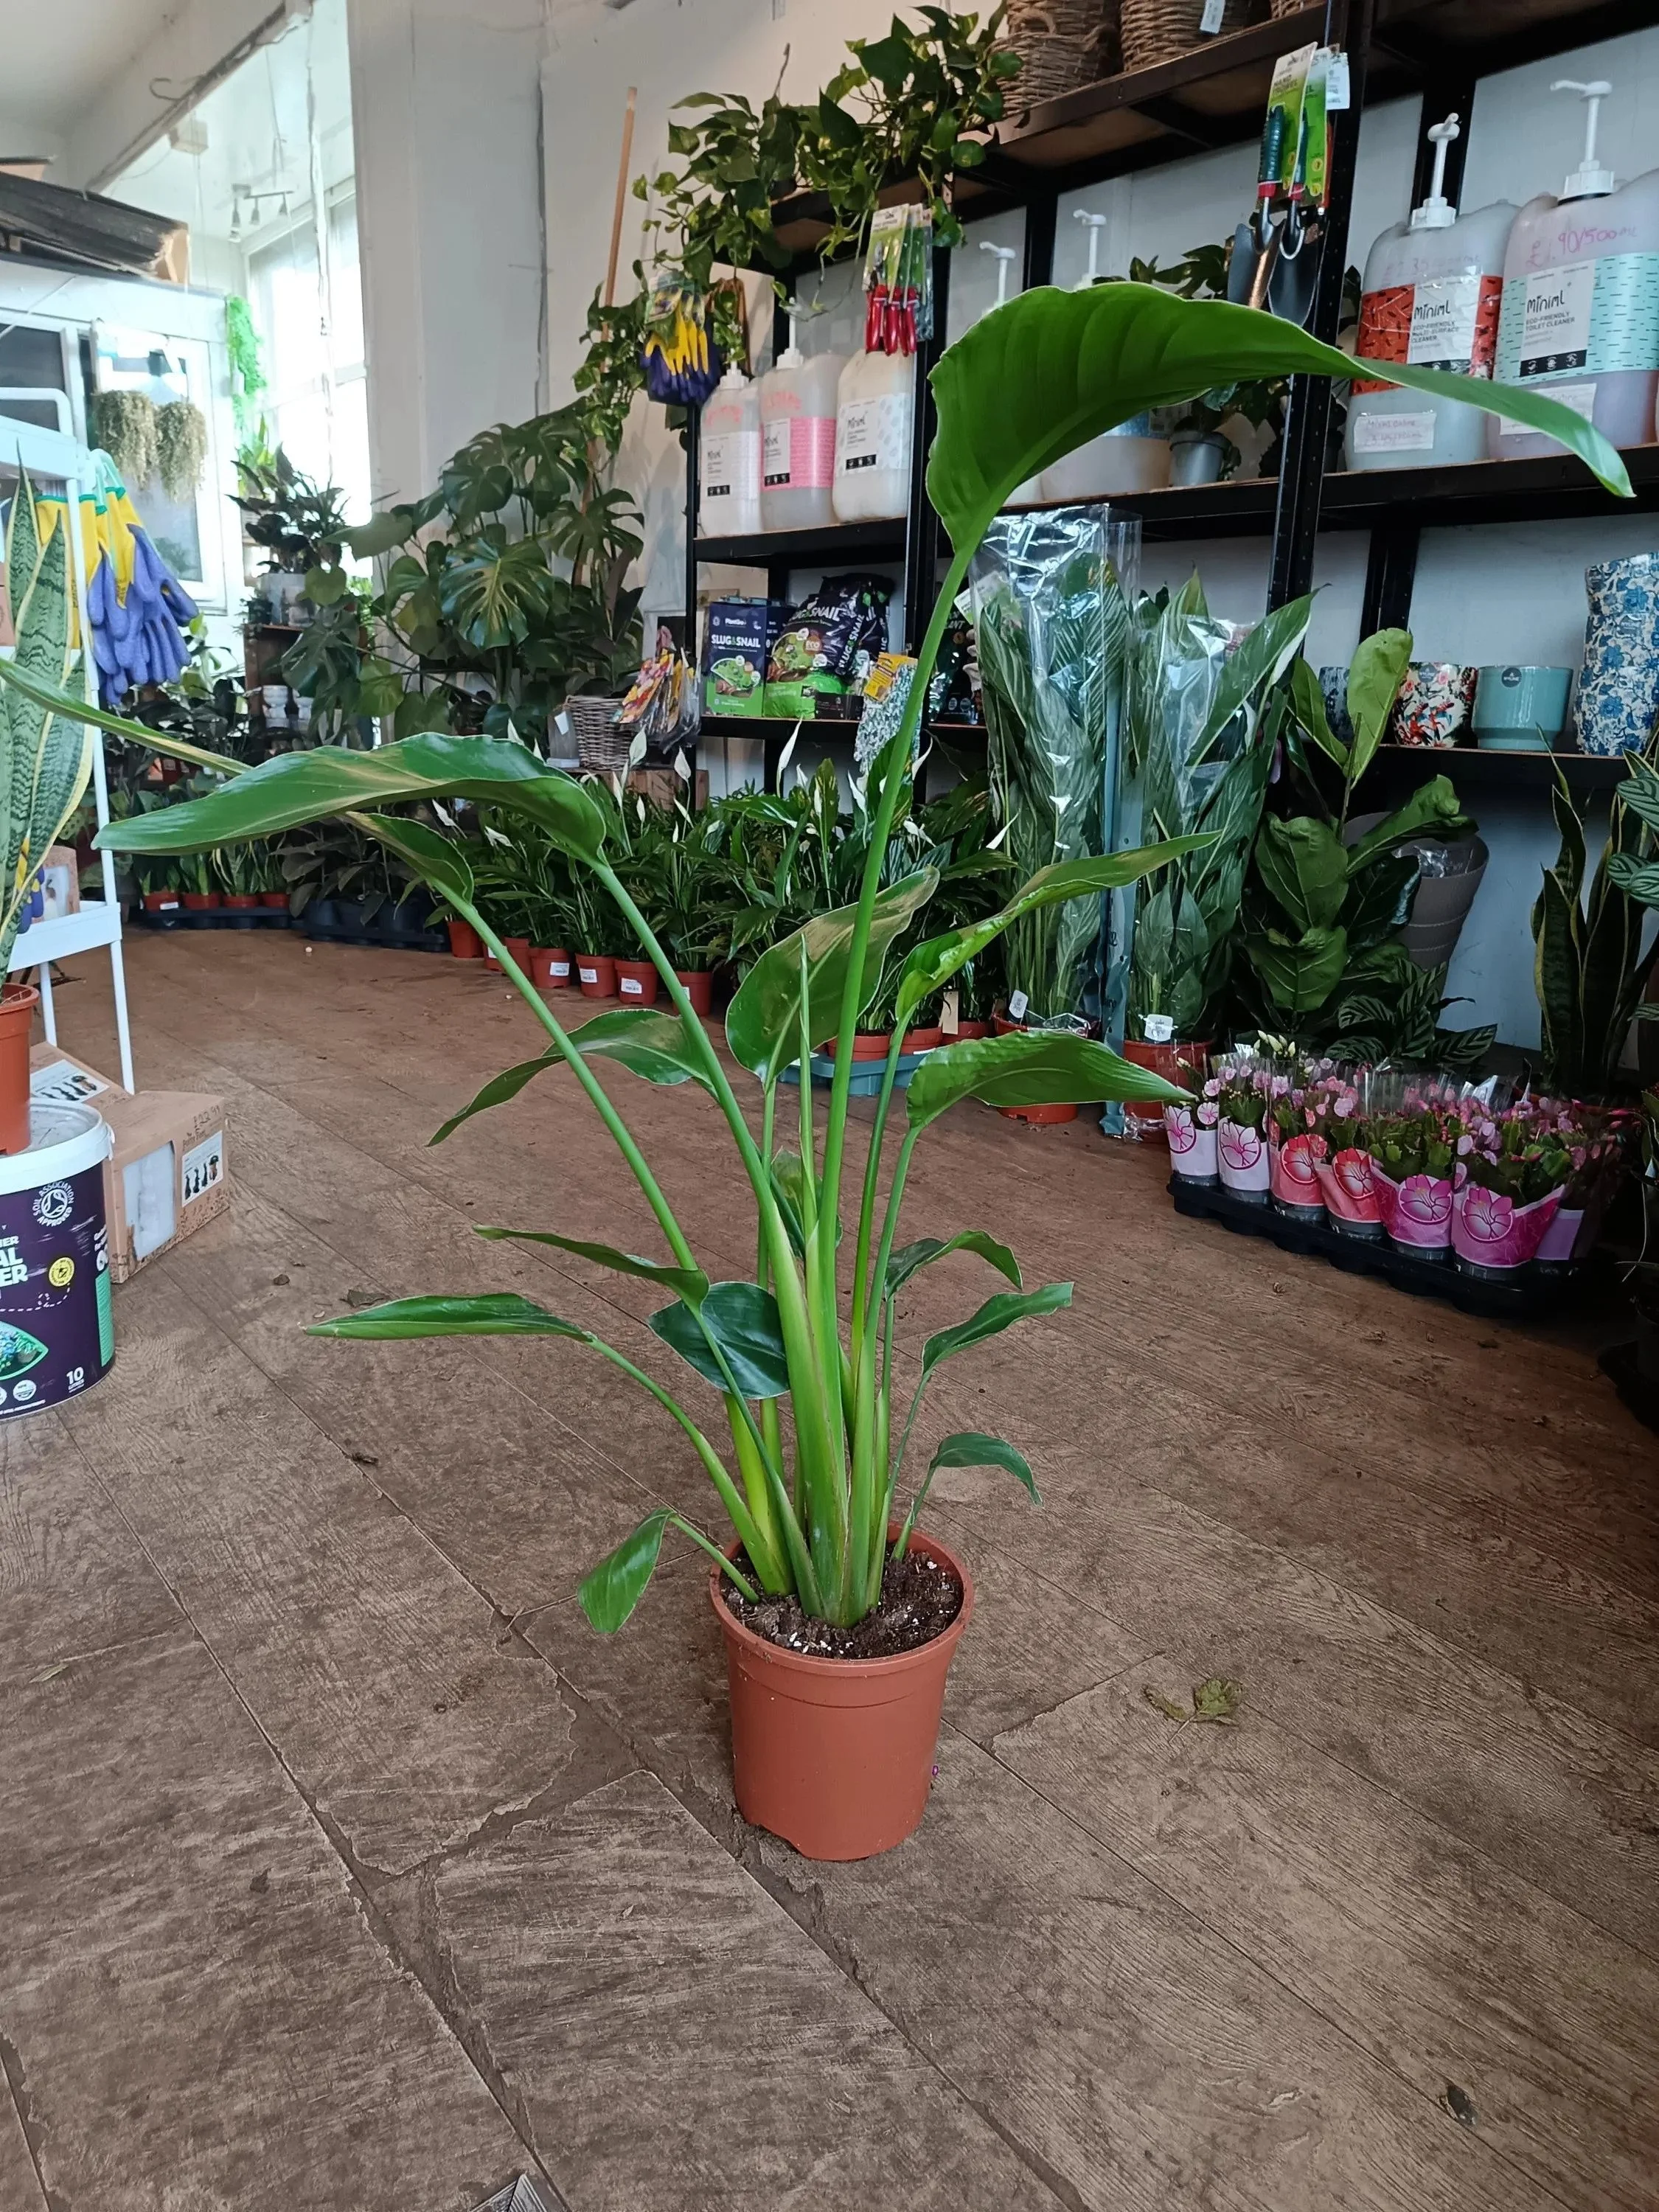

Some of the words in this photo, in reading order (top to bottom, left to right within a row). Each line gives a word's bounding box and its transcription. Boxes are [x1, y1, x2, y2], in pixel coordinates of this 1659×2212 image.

[1547, 317, 1575, 327] CLEANER
[1411, 335, 1437, 343] CLEANER
[32, 1198, 41, 1216] SOIL
[39, 1180, 74, 1204] ASSOCIATION
[37, 1206, 72, 1227] APPROVED
[66, 1366, 84, 1385] 10
